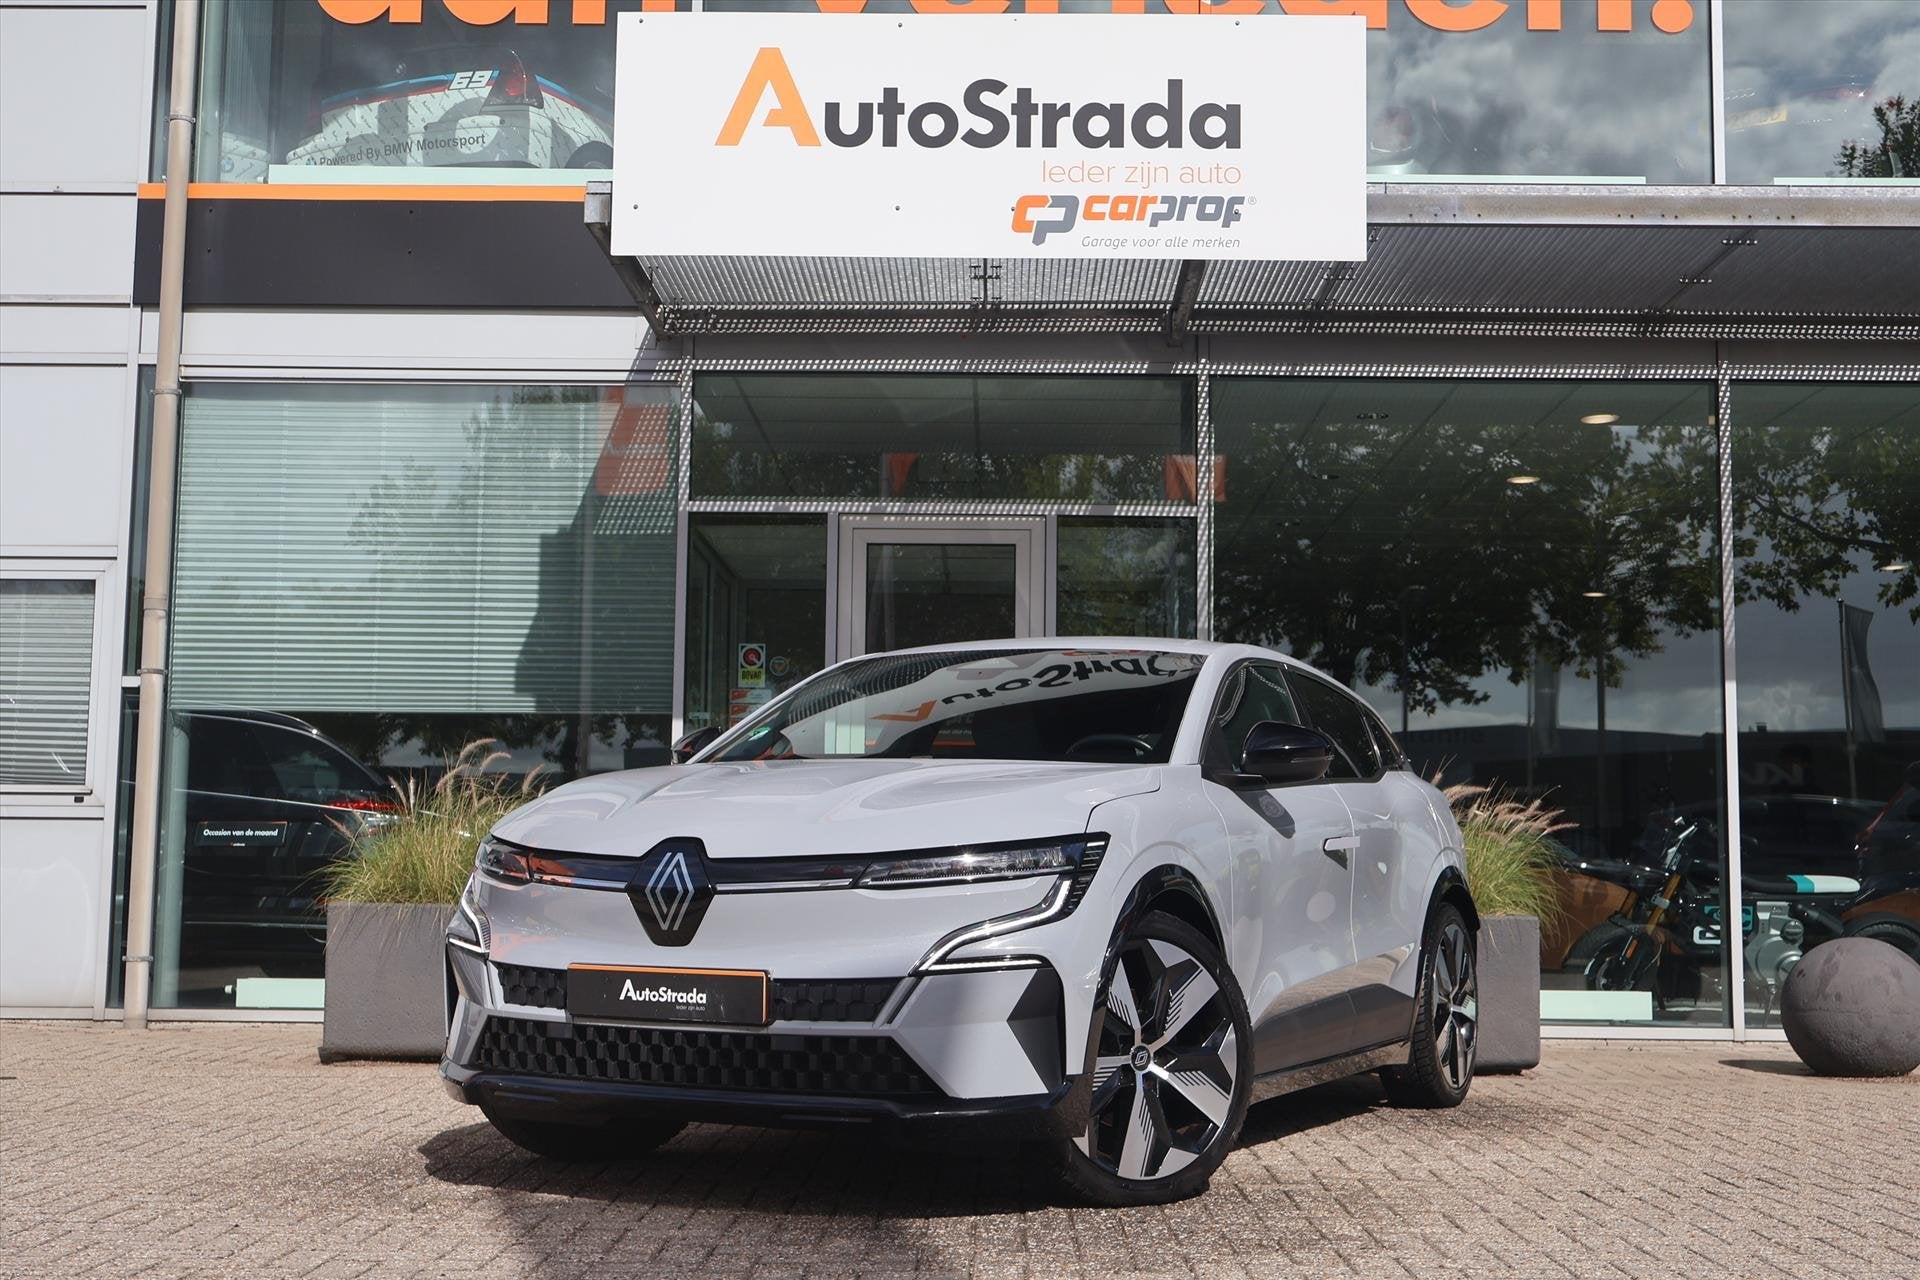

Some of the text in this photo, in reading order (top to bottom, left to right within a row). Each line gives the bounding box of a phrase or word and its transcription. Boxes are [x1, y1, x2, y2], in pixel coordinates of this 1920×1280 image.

[451, 70, 492, 90] 69
[715, 47, 1241, 150] AutoStrada
[319, 134, 486, 166] Powered By BMW Motorsport
[1042, 160, 1242, 189] Ieder zijn auto
[1081, 236, 1241, 249] Garage voor alle merken
[203, 829, 231, 837] Occasion
[245, 828, 253, 837] de
[254, 829, 279, 837] maand
[619, 979, 706, 1004] AutoStrada
